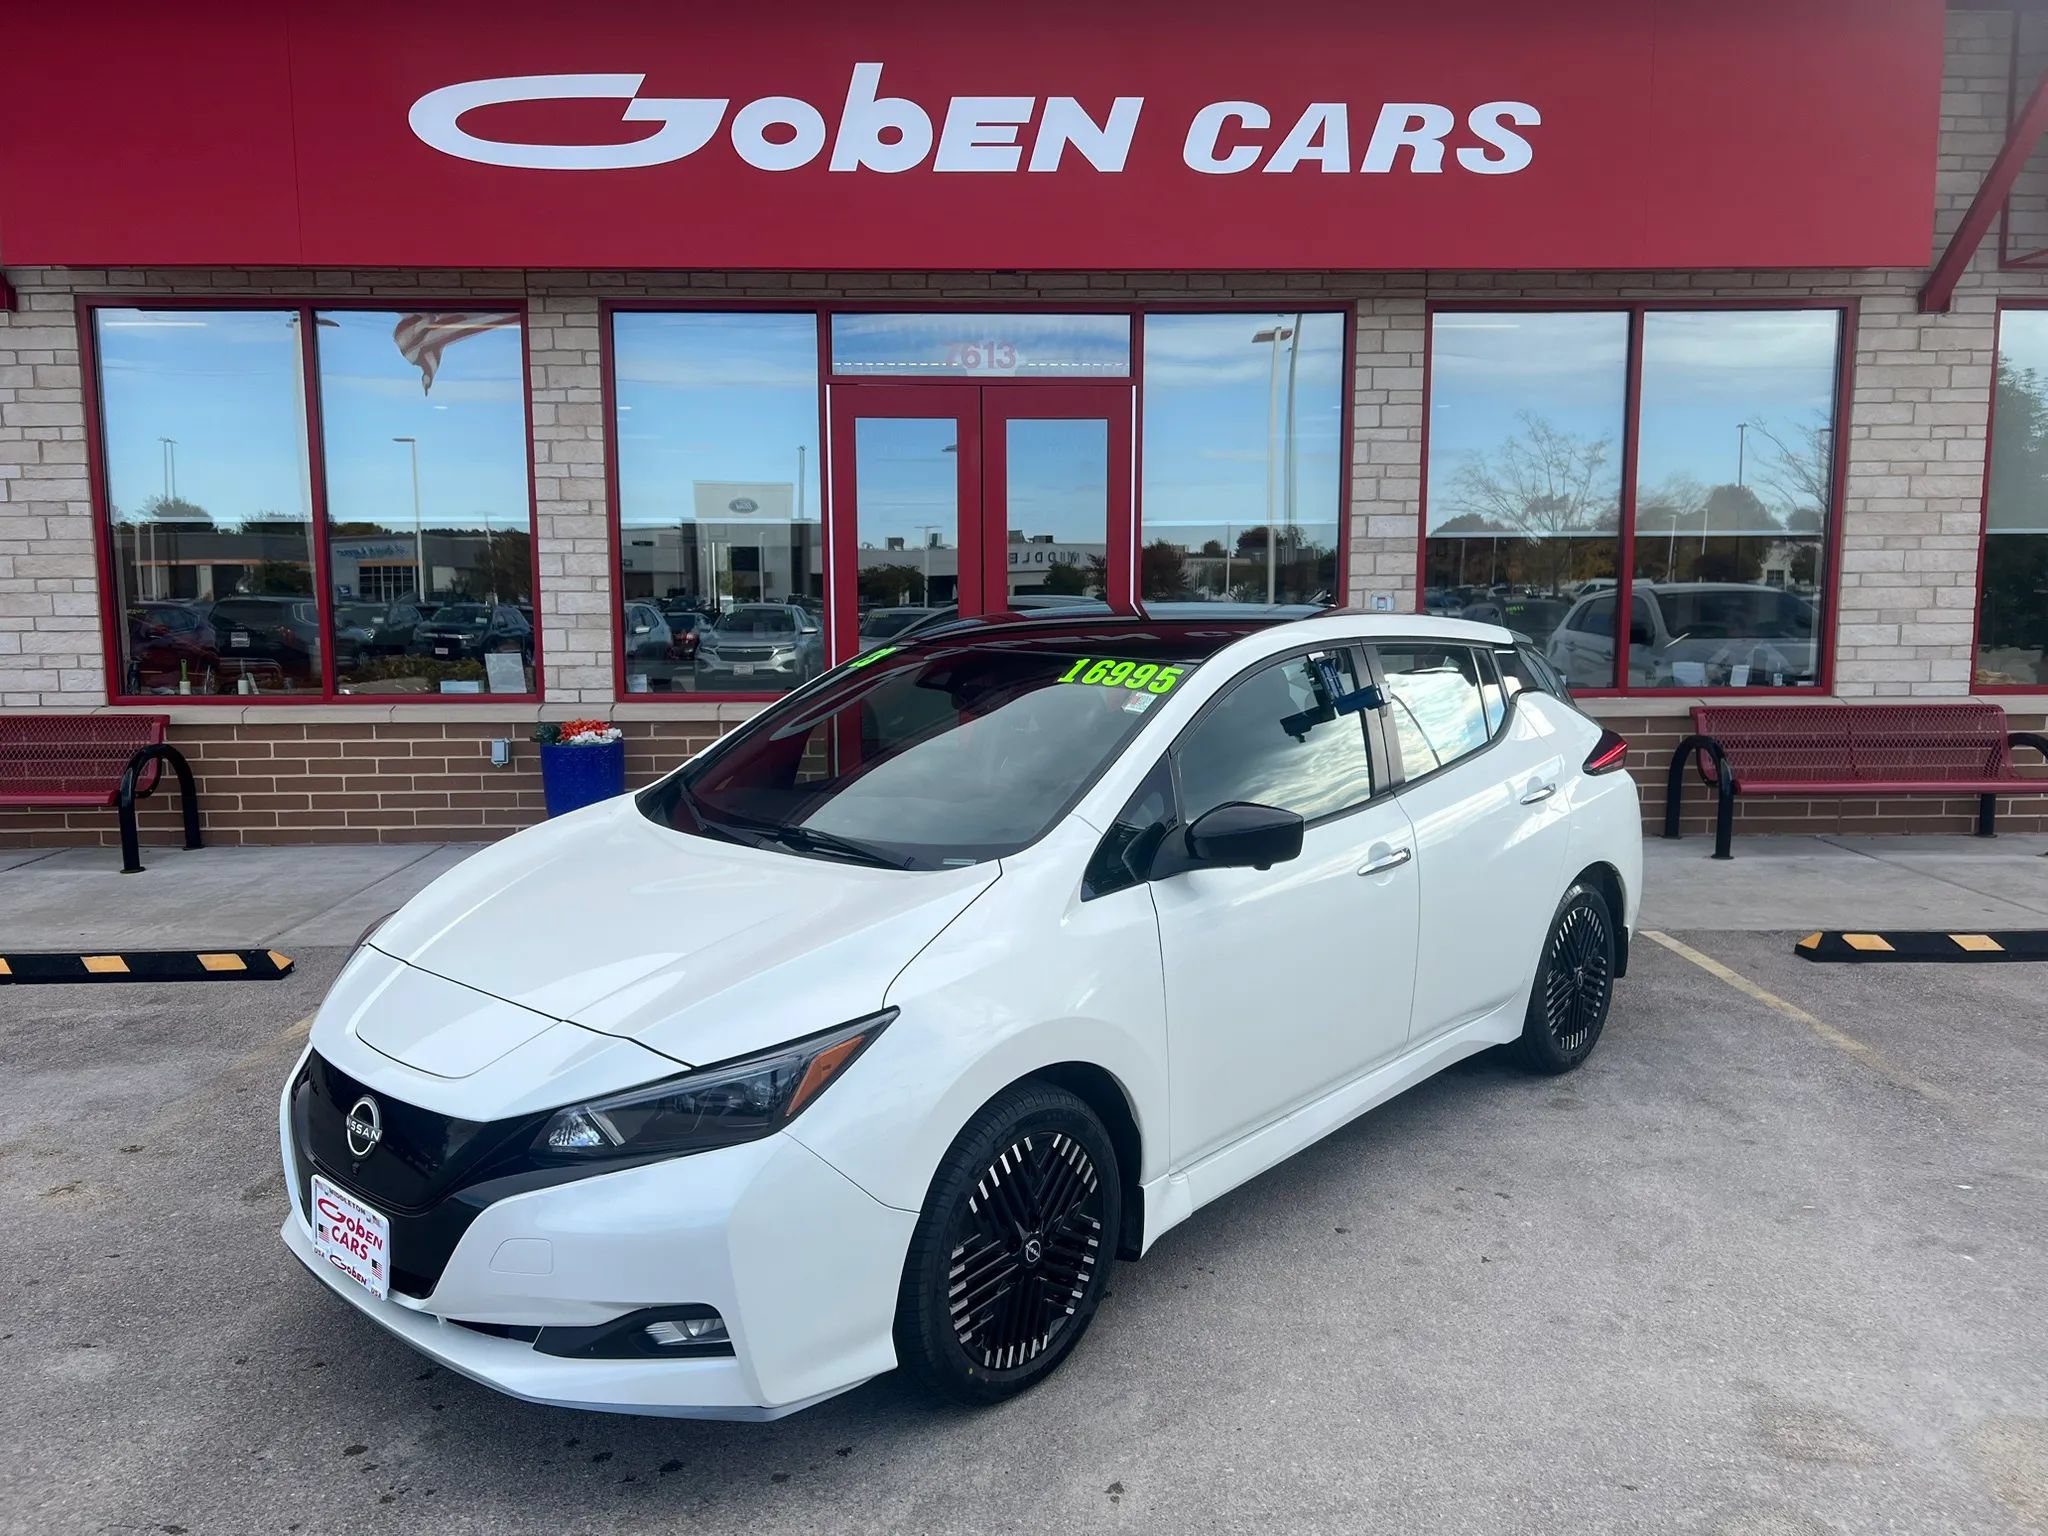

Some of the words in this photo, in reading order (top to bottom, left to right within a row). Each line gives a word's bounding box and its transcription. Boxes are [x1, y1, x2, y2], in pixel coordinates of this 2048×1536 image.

[1183, 101, 1541, 174] CARS
[944, 341, 1016, 369] 7613
[1057, 658, 1184, 694] 16995
[346, 1115, 380, 1141] NISSAN
[329, 1188, 366, 1215] MIDDLETON
[331, 1225, 368, 1261] CARS
